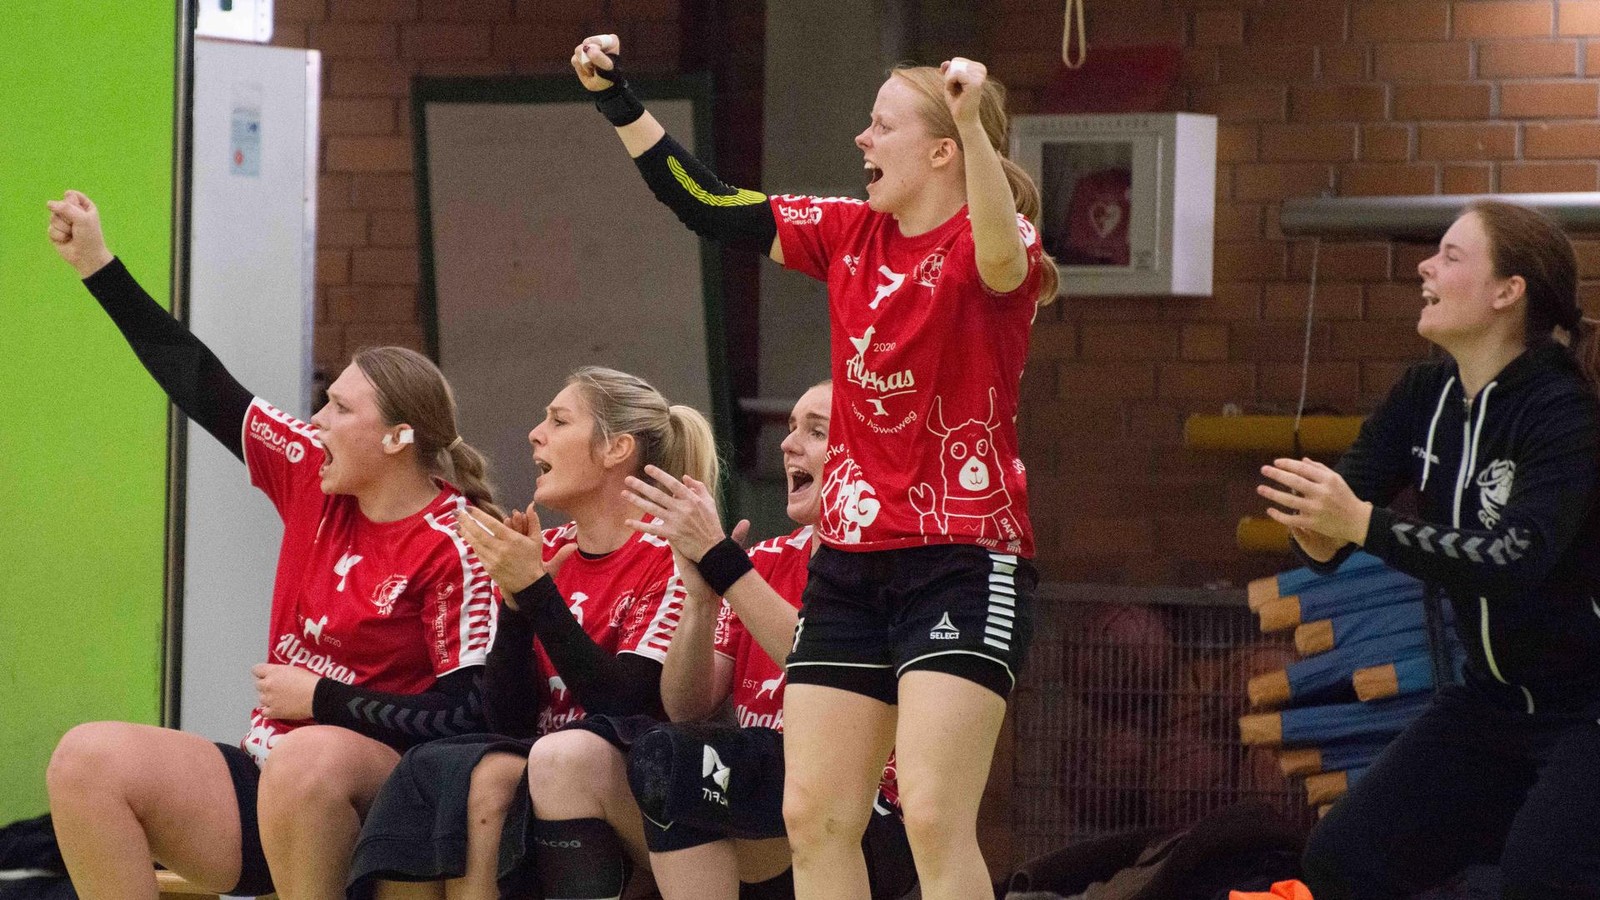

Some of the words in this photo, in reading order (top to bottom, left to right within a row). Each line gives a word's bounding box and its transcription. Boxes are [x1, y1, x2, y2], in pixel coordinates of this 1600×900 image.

[868, 264, 905, 310] 7
[873, 342, 896, 352] 2020
[930, 632, 960, 640] SELECT
[275, 633, 356, 685] Alpakas
